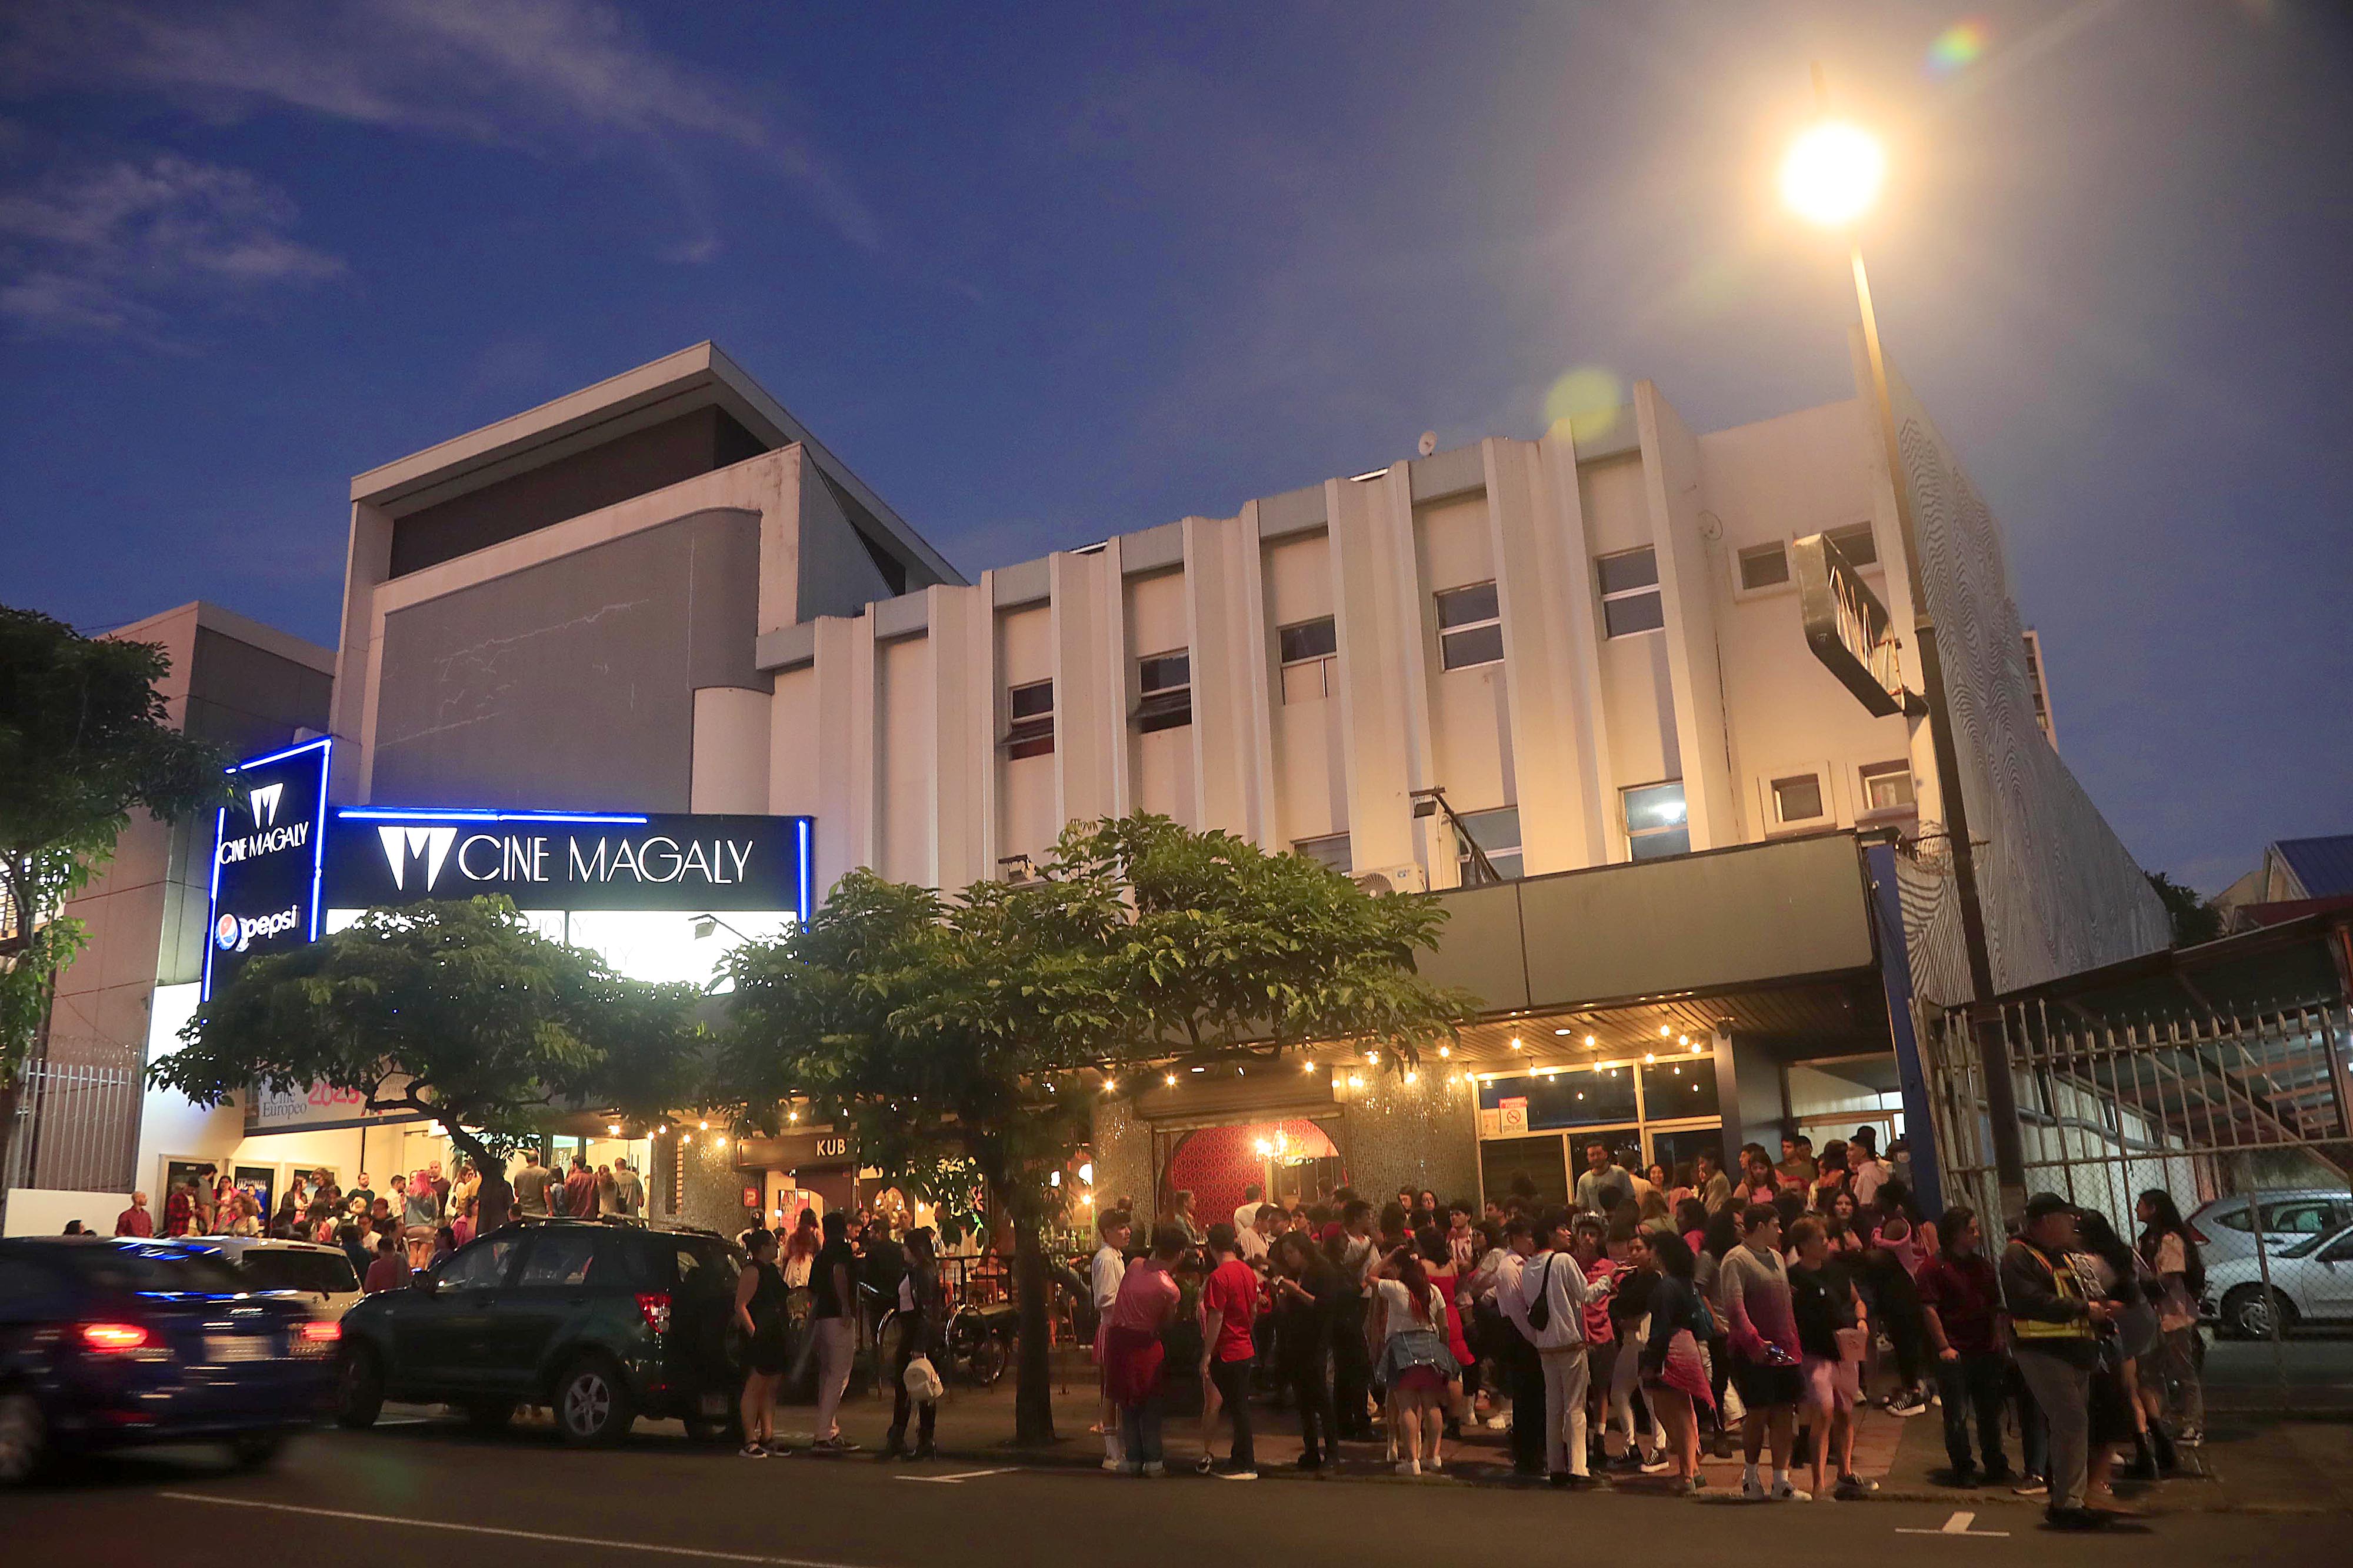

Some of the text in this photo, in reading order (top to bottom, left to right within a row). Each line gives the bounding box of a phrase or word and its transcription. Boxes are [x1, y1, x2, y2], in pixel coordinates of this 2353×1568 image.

[221, 821, 309, 864] CINE MAGALY
[458, 835, 549, 883] CINE
[569, 835, 753, 883] MAGALY
[240, 905, 297, 942] pepsi
[263, 1102, 307, 1119] Europeo
